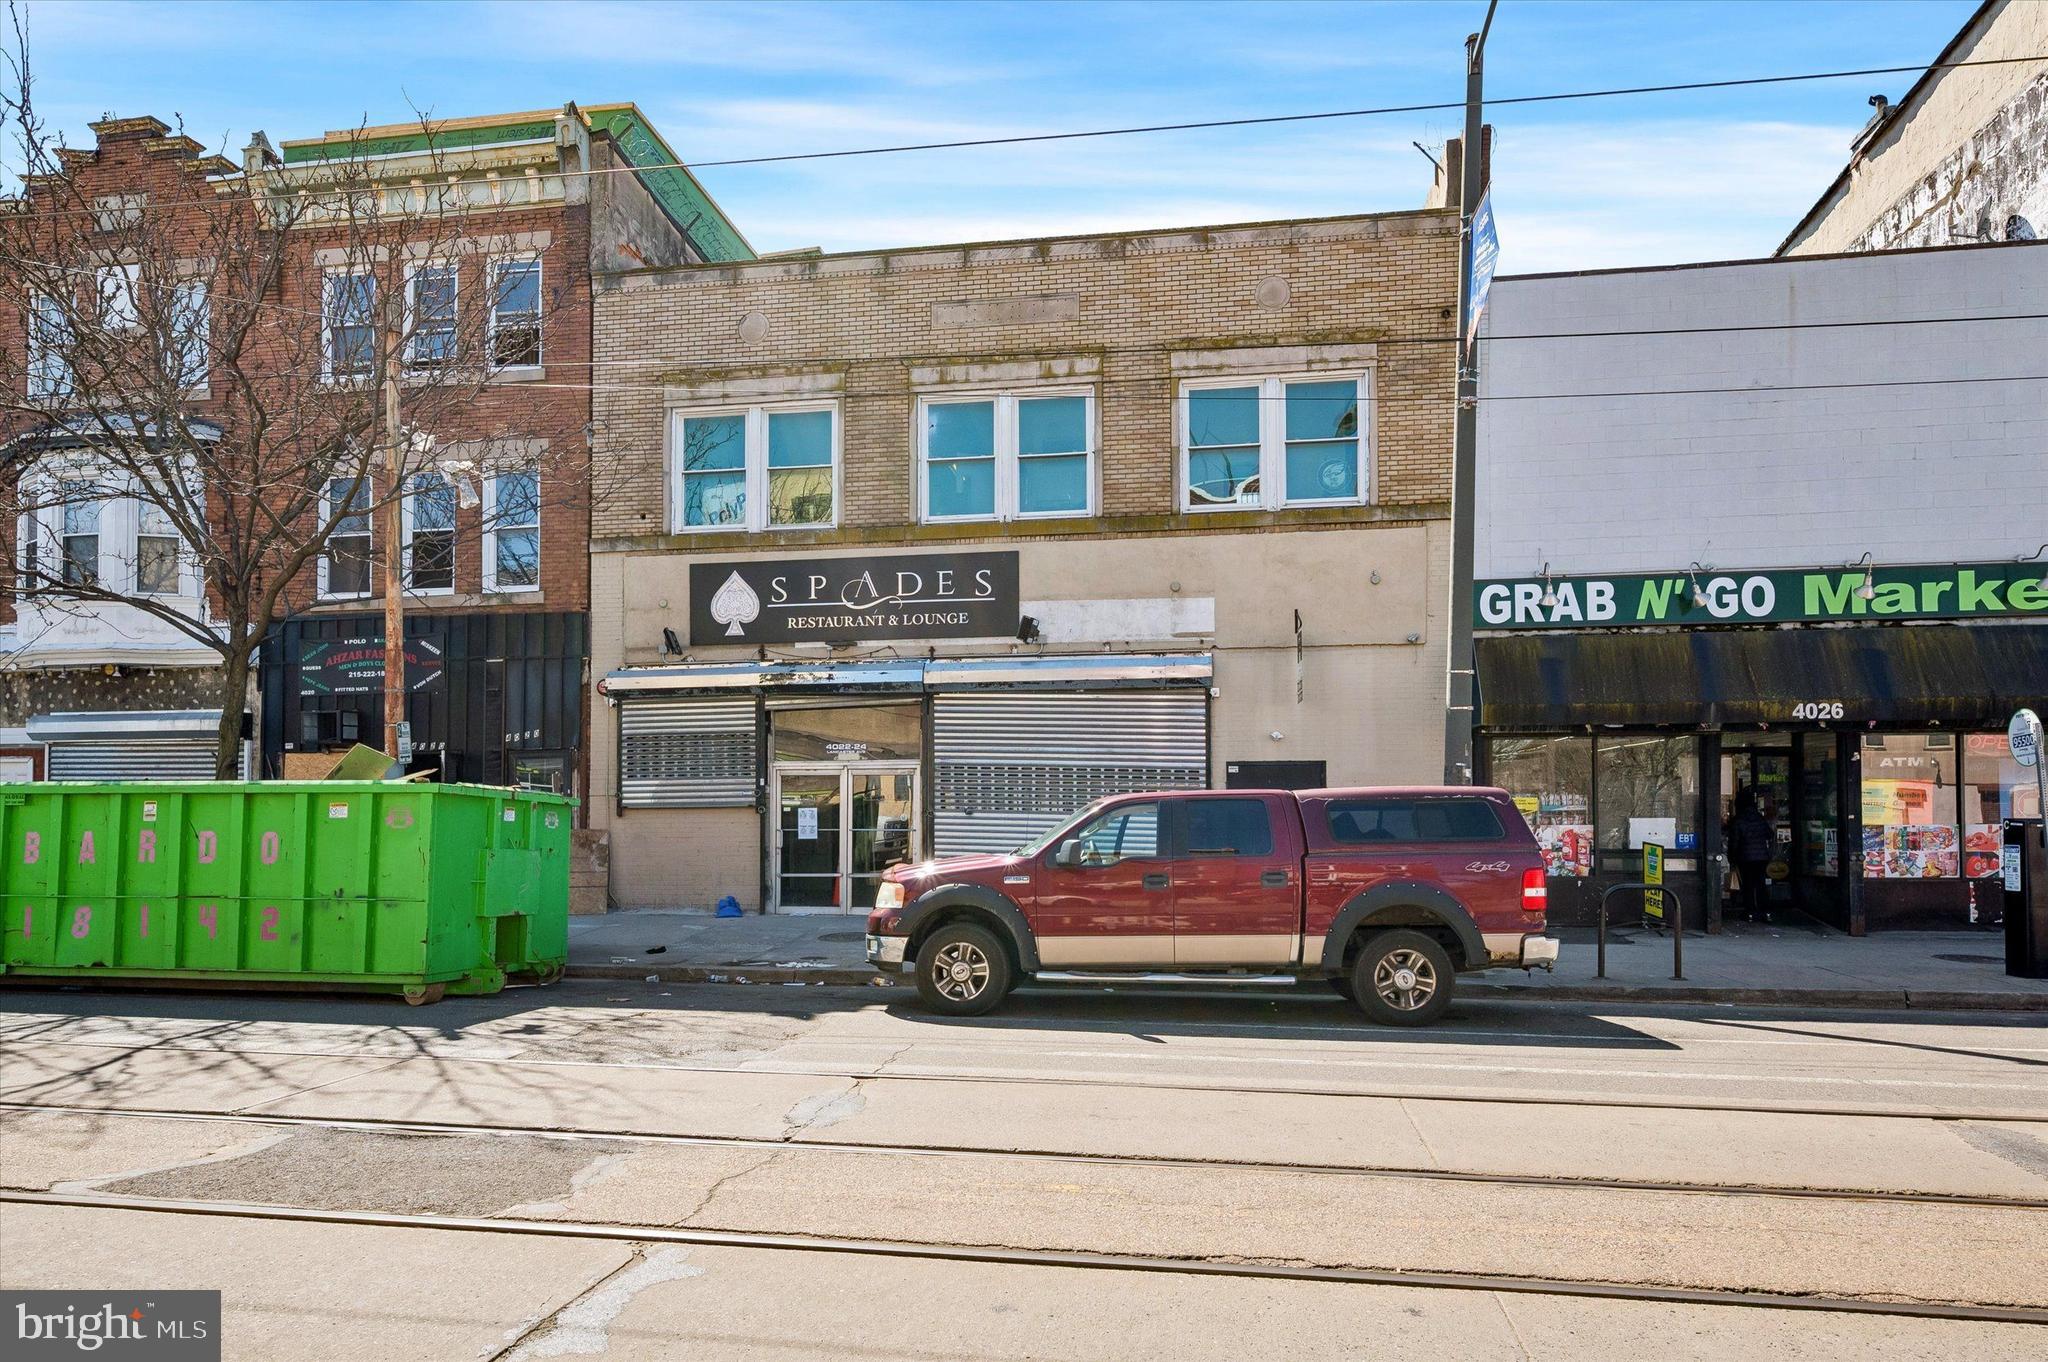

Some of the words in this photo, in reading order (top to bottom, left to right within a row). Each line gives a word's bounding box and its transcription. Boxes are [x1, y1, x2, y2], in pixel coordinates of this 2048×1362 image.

[771, 569, 992, 609] SPADES
[1479, 581, 1617, 625] GRAB
[1636, 578, 1686, 620] N'
[1705, 575, 1776, 618] GO
[1803, 569, 2048, 616] Marke
[787, 614, 886, 629] RESTAURANT
[889, 614, 899, 626] &
[903, 611, 970, 626] LOUNGE
[325, 650, 364, 667] AHZAR
[365, 648, 417, 665] FASNS
[1792, 702, 1844, 720] 4026
[1879, 757, 1924, 767] ATM
[1678, 833, 1695, 843] EBT
